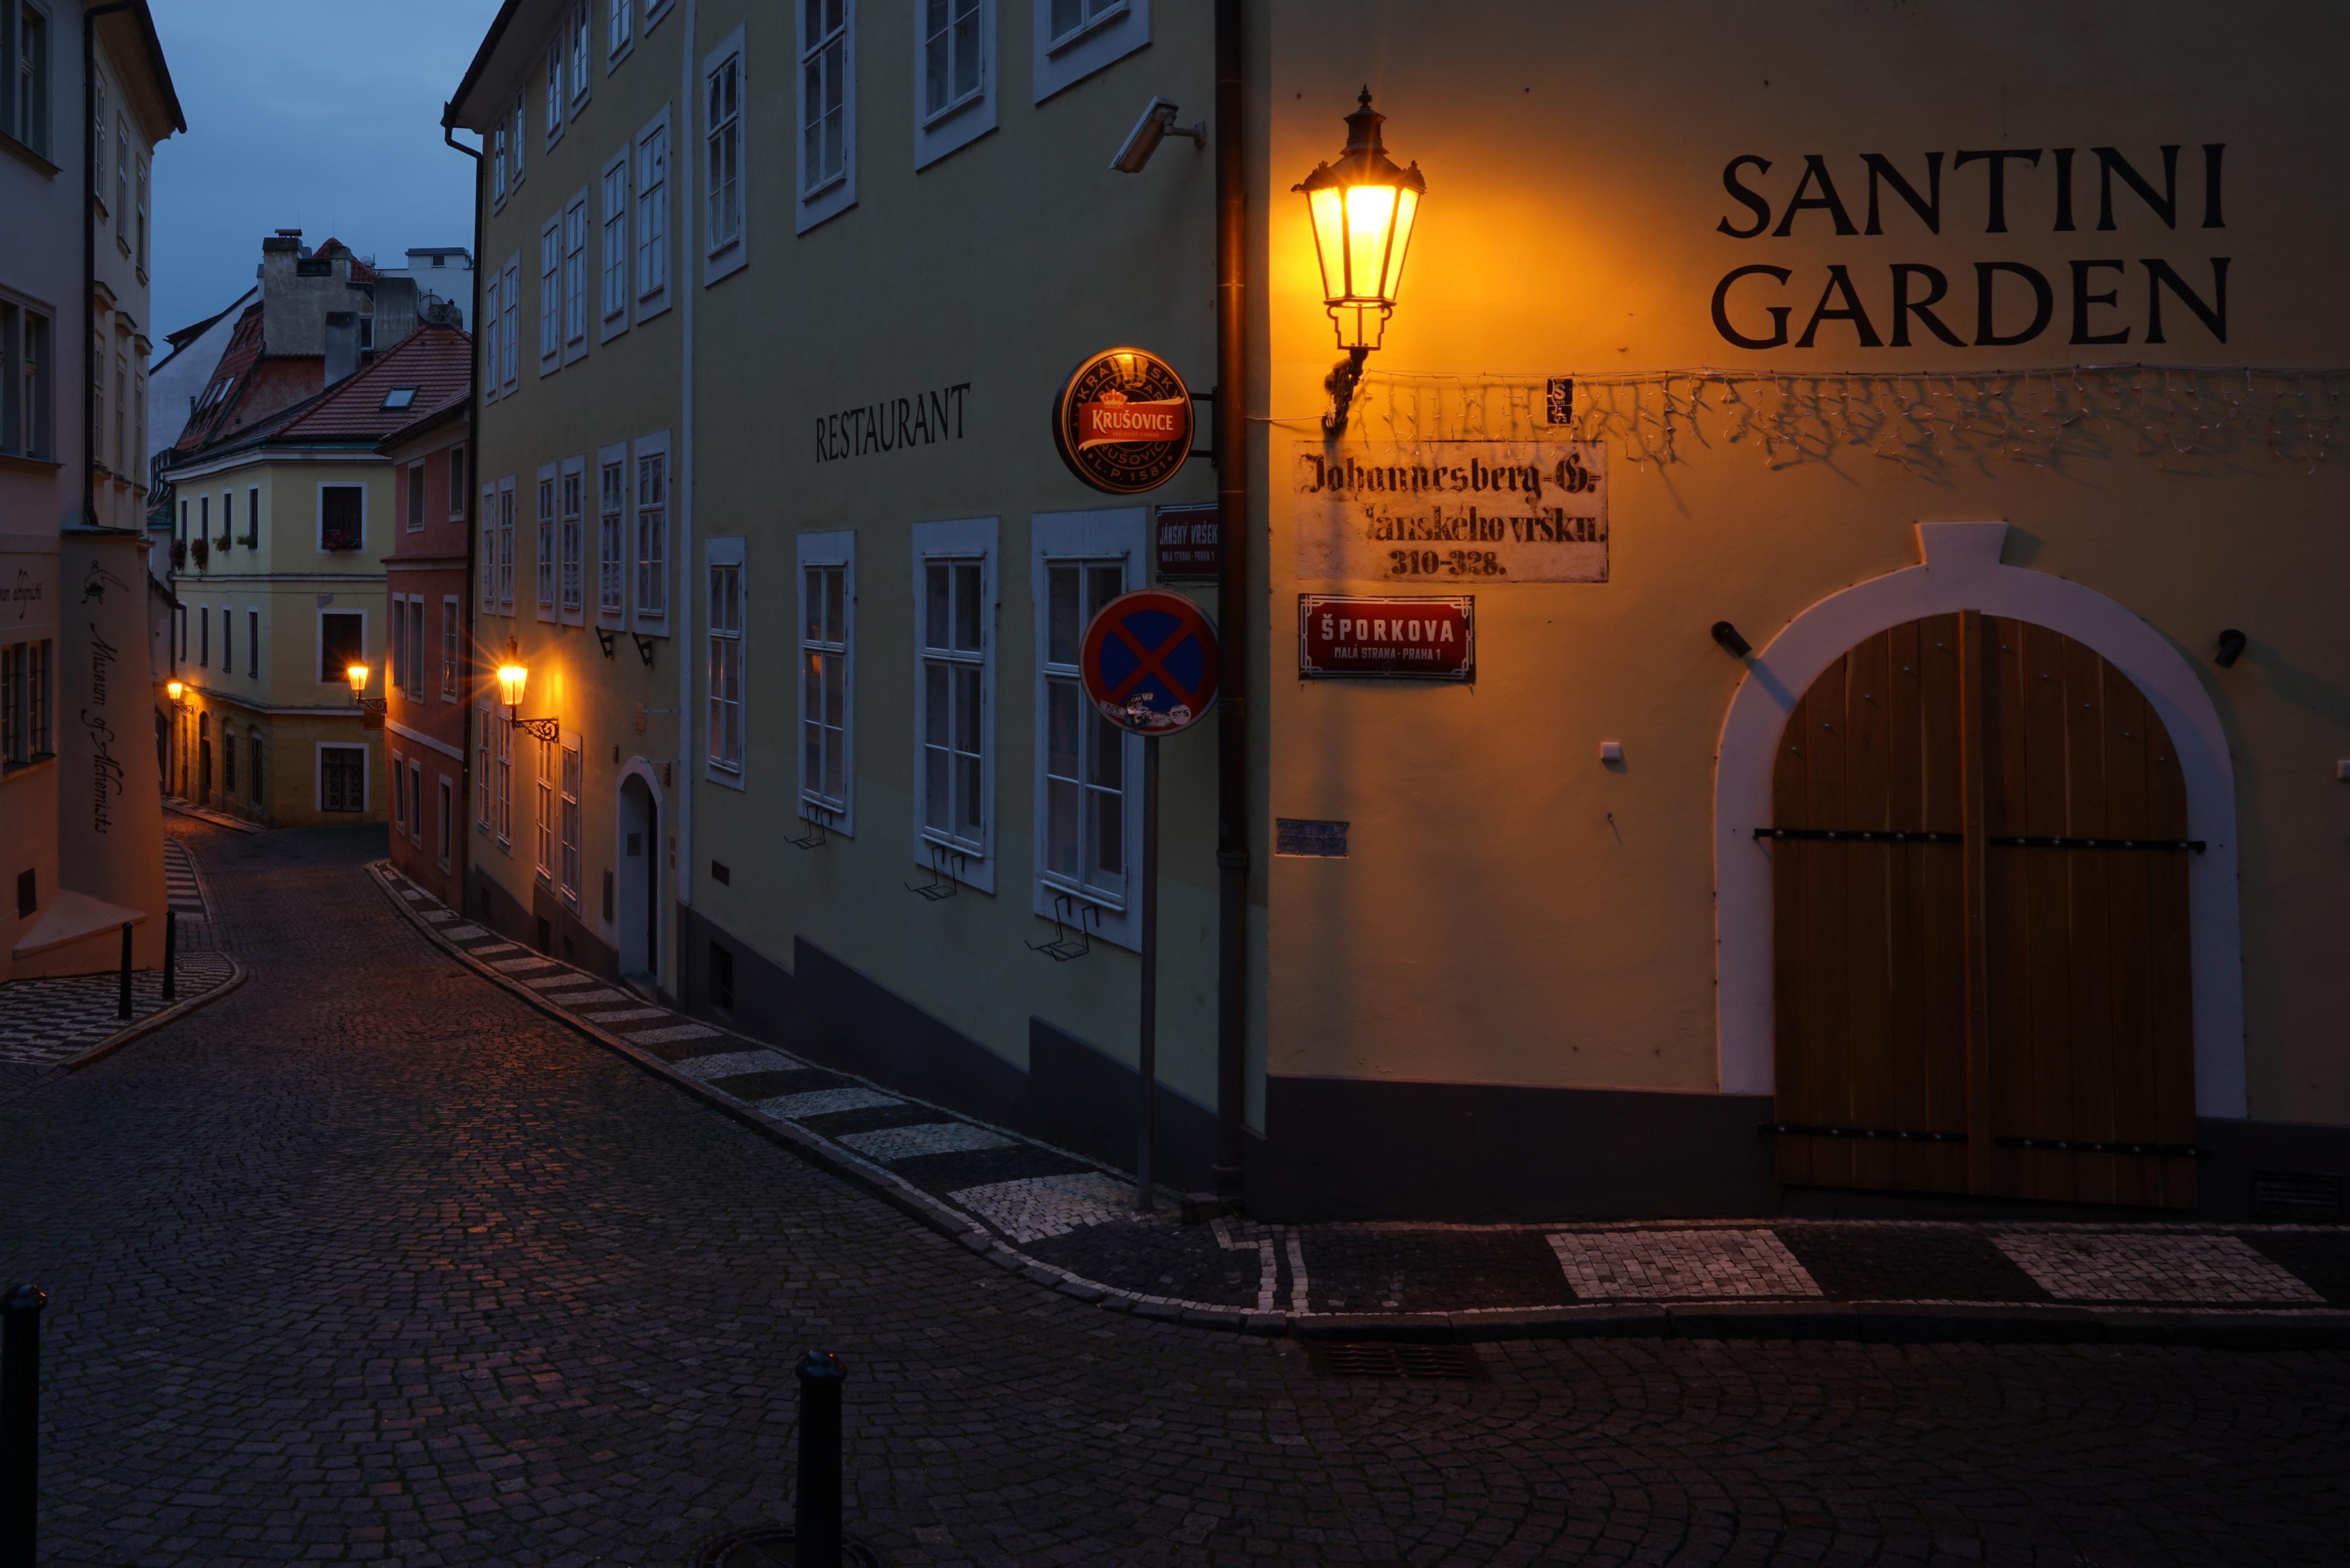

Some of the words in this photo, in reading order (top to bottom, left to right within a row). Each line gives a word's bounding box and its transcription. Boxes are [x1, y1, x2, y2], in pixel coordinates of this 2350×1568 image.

[1716, 144, 2225, 238] SANTINI
[1711, 257, 2231, 349] GARDEN
[816, 382, 971, 463] RESTAURANT
[1092, 409, 1174, 434] KRUŠOVICE
[1130, 461, 1167, 482] 1581
[1191, 520, 1218, 545] VRŠEK
[1389, 550, 1507, 575] 310-328.
[1321, 613, 1454, 642] ŠPORKOVA
[89, 622, 118, 706] Museum
[1334, 644, 1358, 659] MALÁ
[1361, 647, 1395, 659] STRANA
[1402, 647, 1433, 660] PRAHA
[1436, 649, 1441, 660] 1
[80, 709, 115, 742] of
[90, 731, 124, 835] Alchemists
